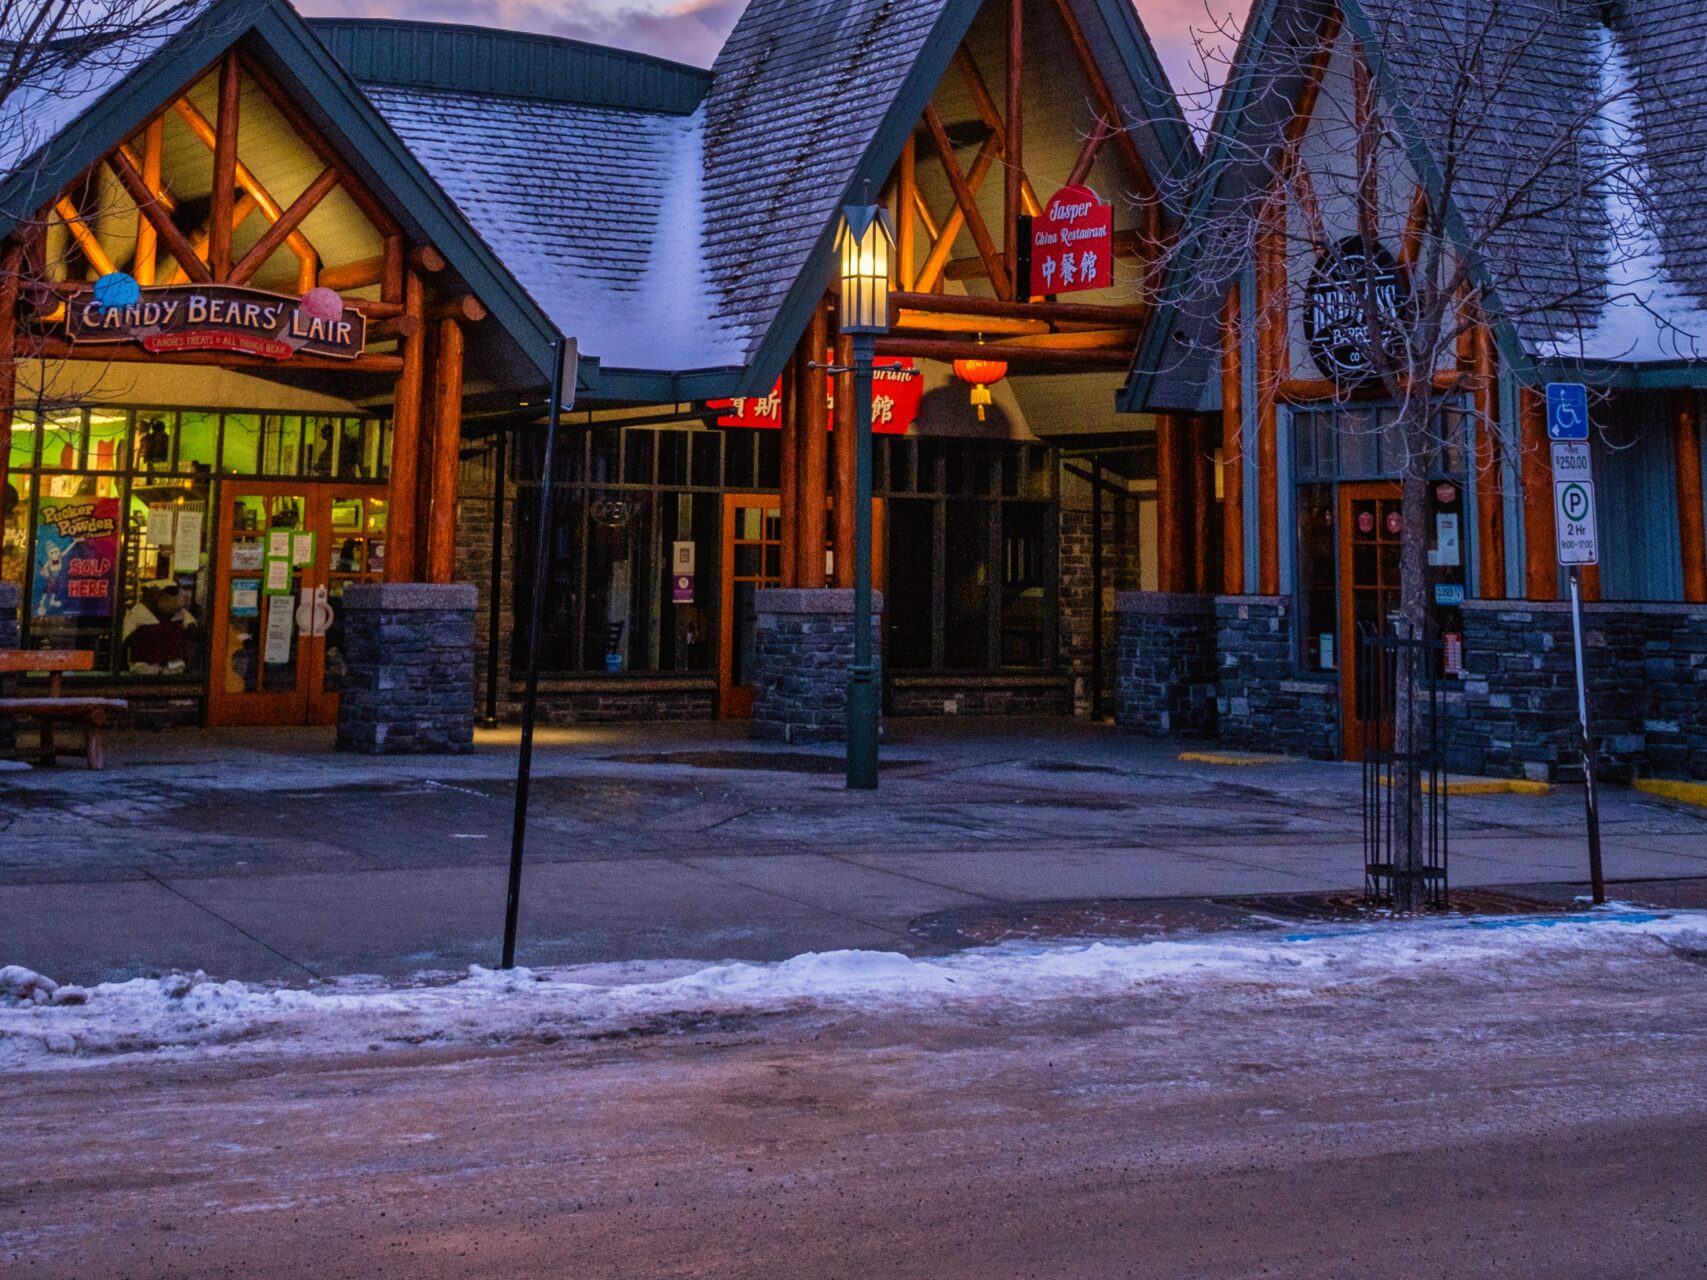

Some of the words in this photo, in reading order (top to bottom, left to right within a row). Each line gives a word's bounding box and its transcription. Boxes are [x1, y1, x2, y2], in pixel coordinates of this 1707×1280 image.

[1050, 200, 1092, 224] Jasper
[1035, 231, 1058, 246] China
[1060, 224, 1107, 247] Restaurant
[1041, 250, 1098, 288] 中餐館
[82, 301, 179, 329] CANDY
[187, 295, 284, 330] BEARS'
[292, 308, 352, 345] LAIR
[222, 336, 237, 346] ALL
[1555, 455, 1587, 470] $250.00
[1569, 492, 1581, 512] P
[41, 504, 96, 524] Pucker
[58, 518, 115, 537] Powder
[1567, 523, 1574, 536] 2
[1575, 524, 1586, 536] Hr
[68, 557, 111, 577] SOLD
[67, 579, 109, 598] HERE
